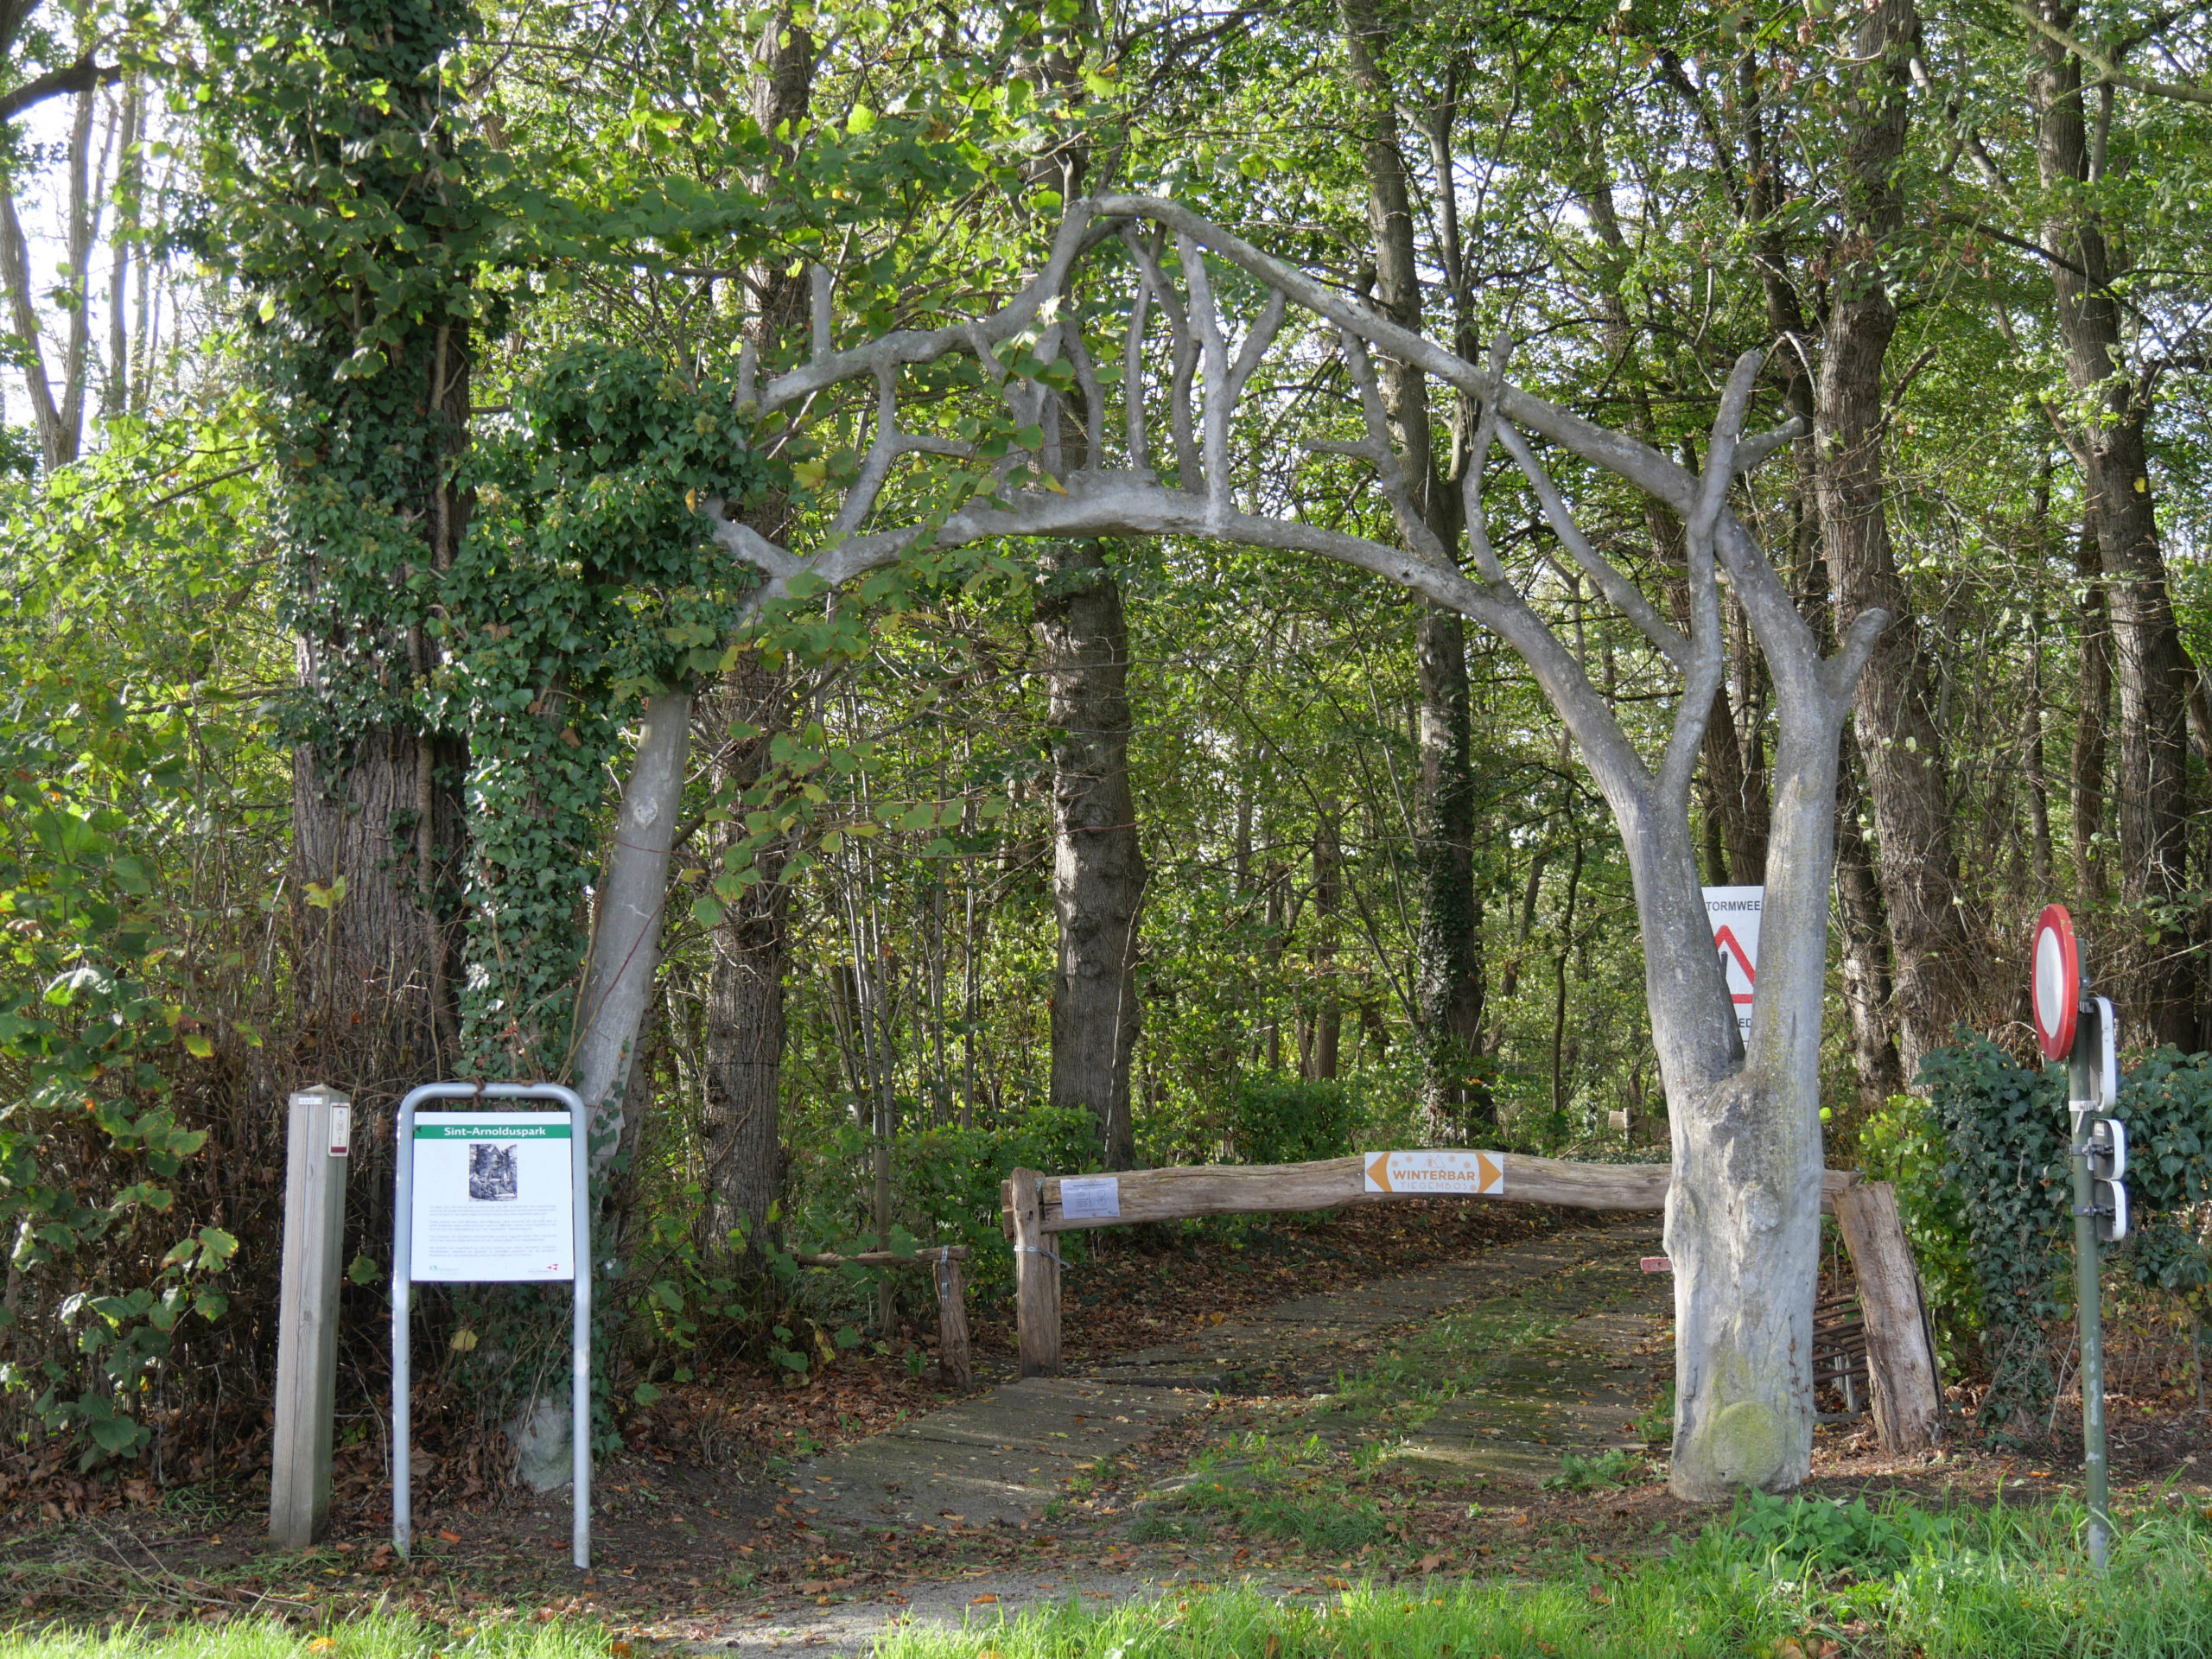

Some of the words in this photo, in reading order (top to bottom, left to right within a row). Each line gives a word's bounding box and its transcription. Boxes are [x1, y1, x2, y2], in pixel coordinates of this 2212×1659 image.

[1706, 900, 1761, 912] TORMWEE
[443, 1126, 546, 1137] Sint-Arnolduspark
[1392, 1169, 1476, 1181] WINTERBAR
[1400, 1180, 1468, 1190] TIEGEMBOS
